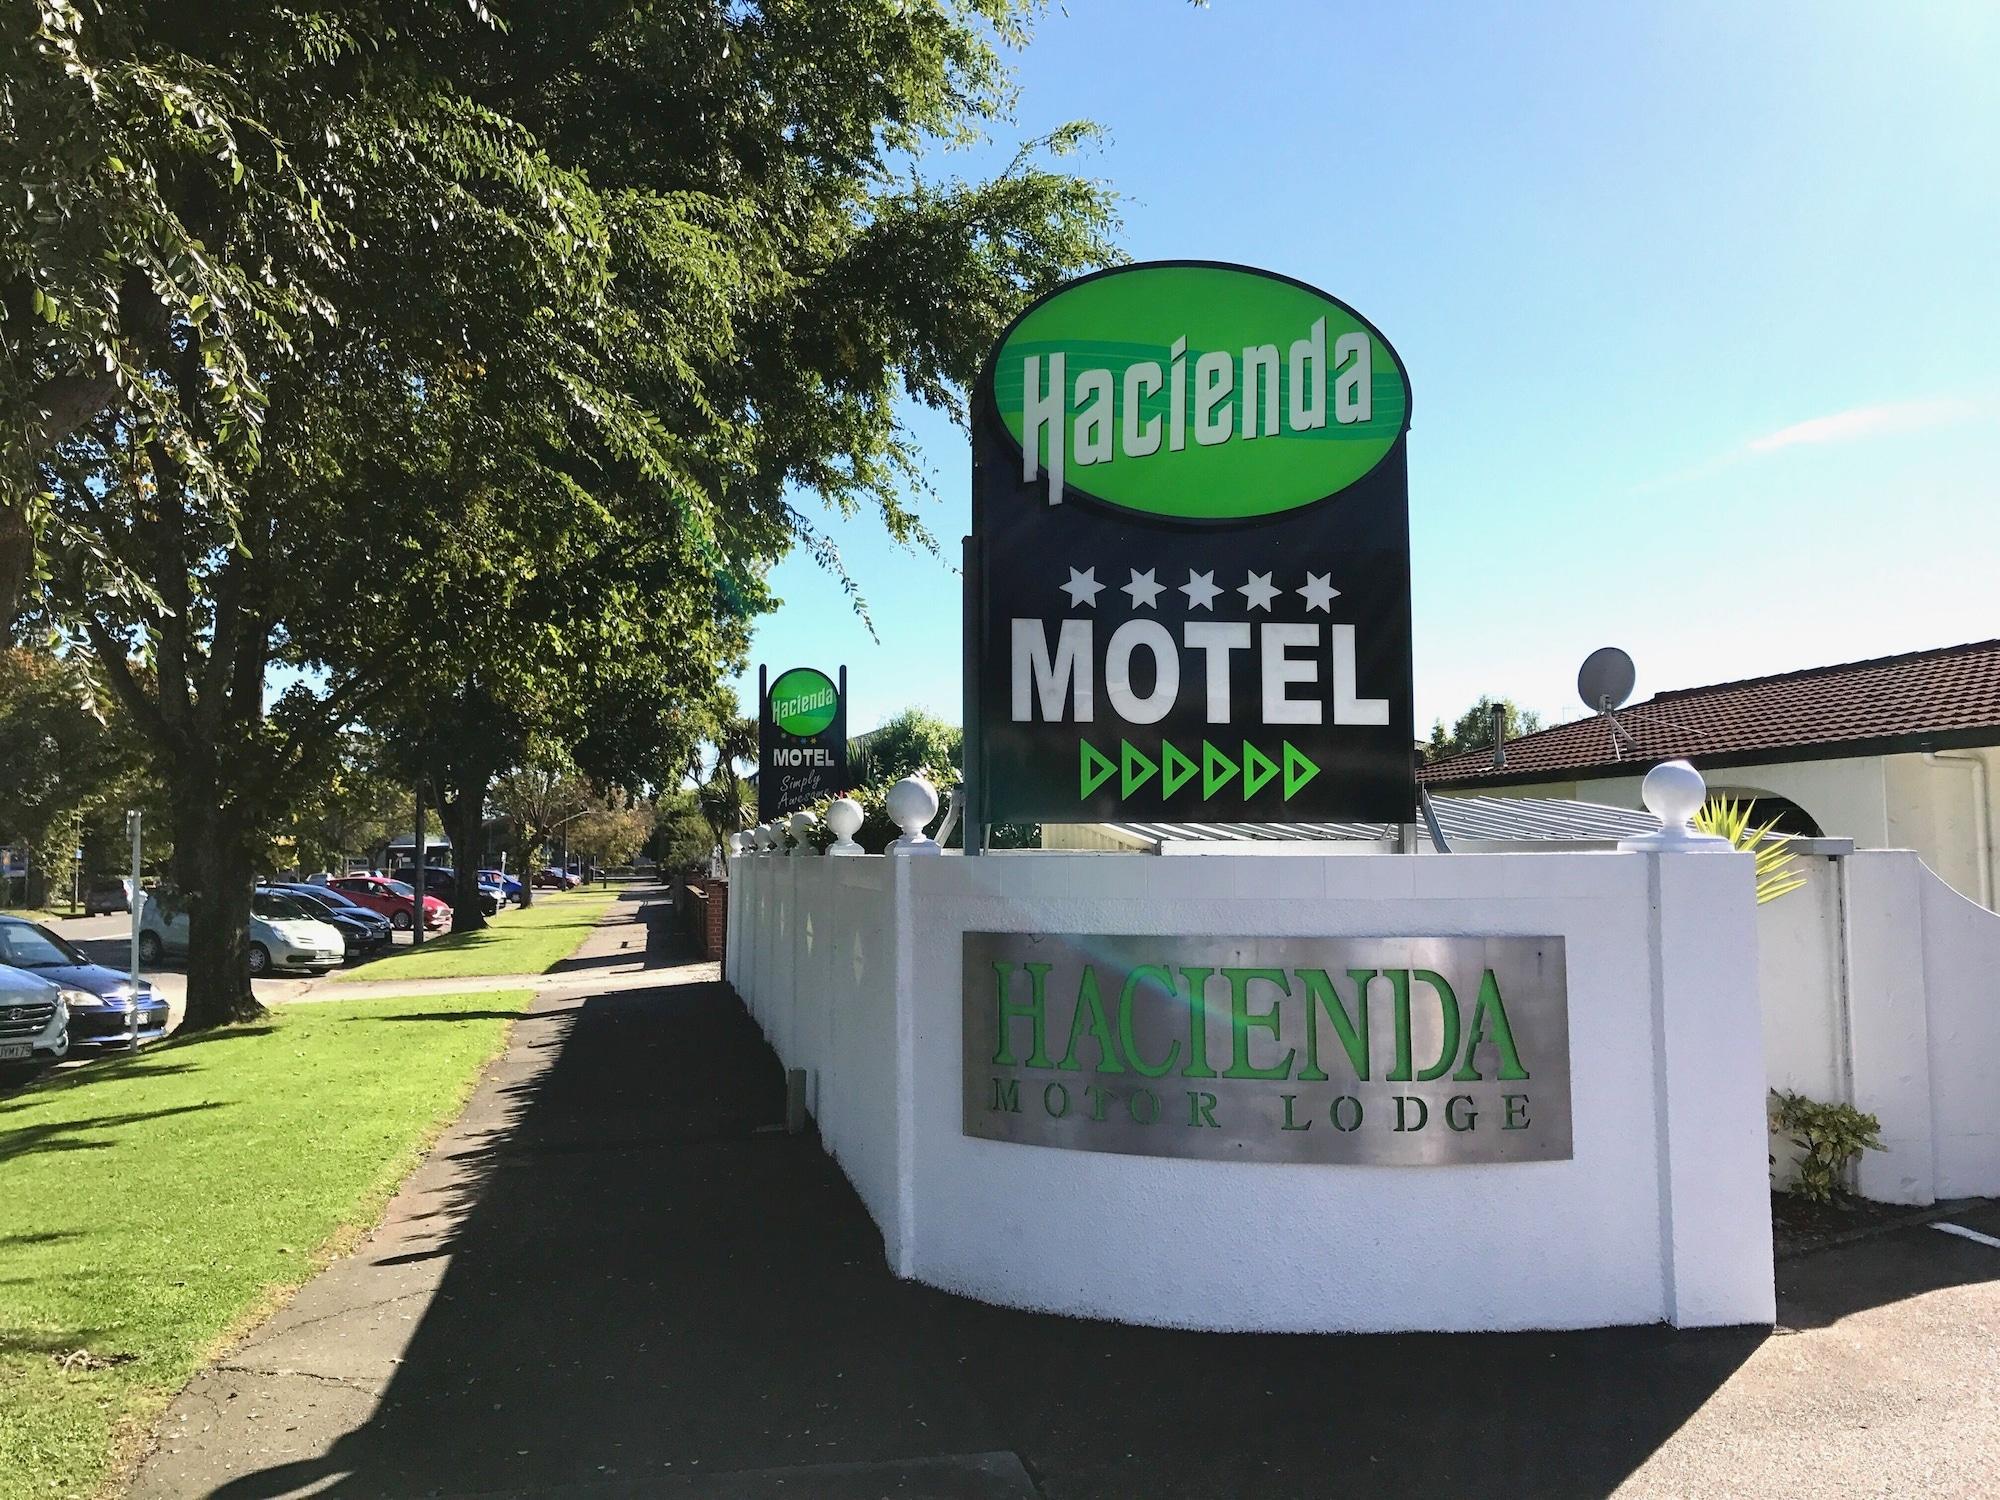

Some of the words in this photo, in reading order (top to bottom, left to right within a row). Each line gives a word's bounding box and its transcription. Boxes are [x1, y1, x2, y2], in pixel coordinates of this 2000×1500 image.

[1023, 315, 1372, 506] Hacienda
[1011, 618, 1390, 726] MOTEL
[772, 687, 834, 727] Hacienda
[773, 748, 835, 767] MOTEL
[780, 769, 821, 792] Simply
[992, 961, 1531, 1082] HACIENDA
[992, 1077, 1222, 1129] MOTOR
[1280, 1094, 1532, 1133] LODGE
